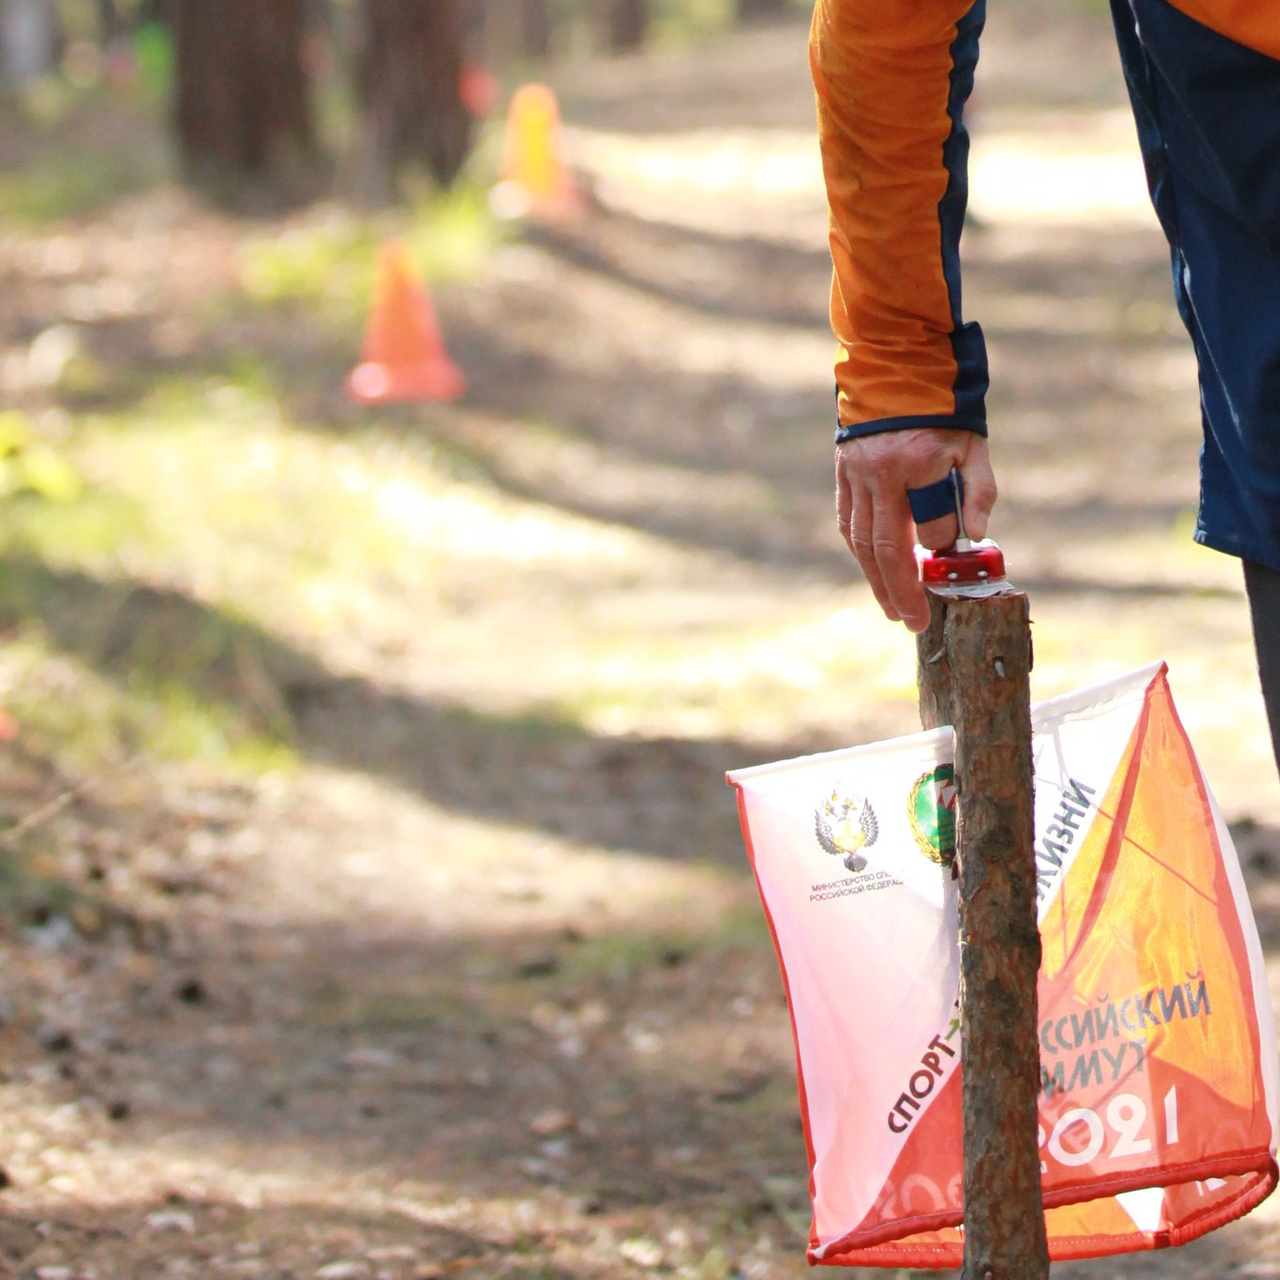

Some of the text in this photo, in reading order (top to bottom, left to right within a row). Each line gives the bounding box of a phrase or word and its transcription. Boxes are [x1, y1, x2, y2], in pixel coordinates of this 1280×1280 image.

[809, 878, 903, 902] РОССИЙСКОЙ ФЕДЕРА
[811, 874, 875, 893] МИНИСТЕРСТВО
[1040, 970, 1212, 1053] ССИЙСКИЙ
[887, 1034, 956, 1134] СПОРТ
[1038, 1038, 1147, 1100] ИМУТ
